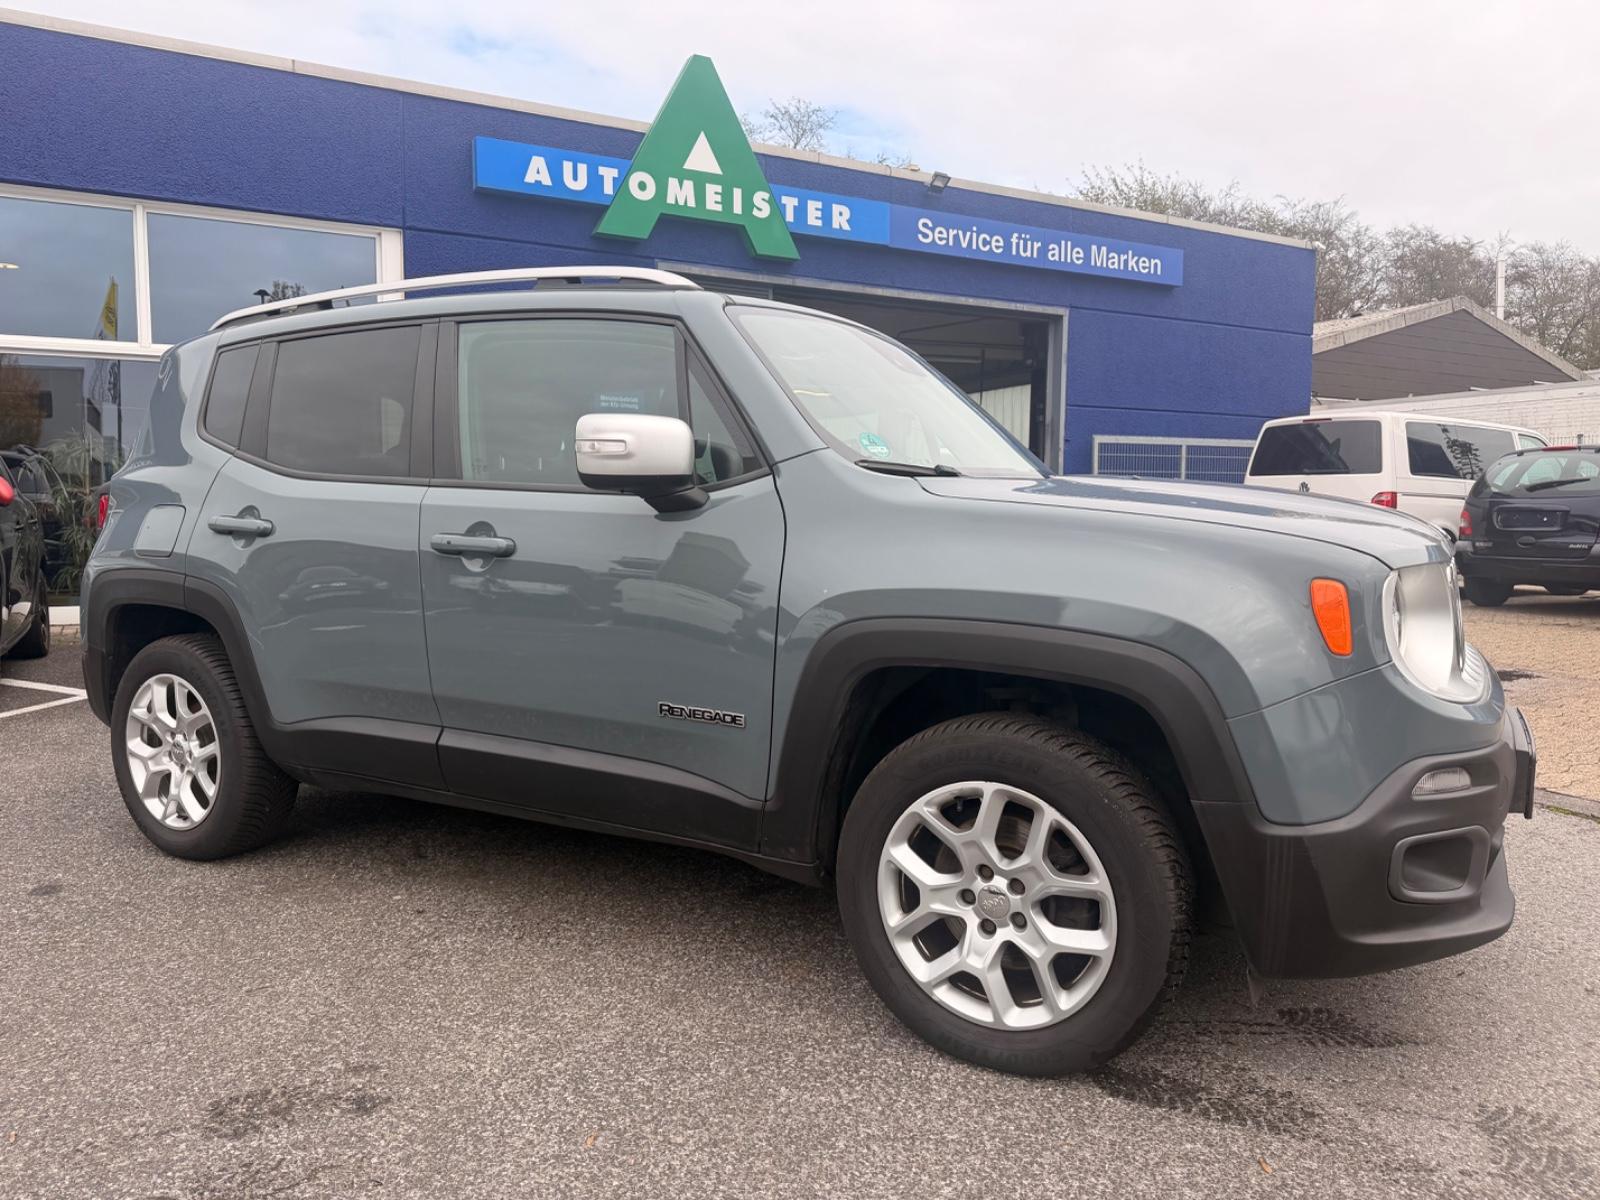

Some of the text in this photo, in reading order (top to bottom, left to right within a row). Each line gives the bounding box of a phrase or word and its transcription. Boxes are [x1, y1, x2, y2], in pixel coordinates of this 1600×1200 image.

[524, 156, 851, 231] AUTOMEISTER
[917, 217, 1163, 275] Service für alle Marken
[658, 701, 745, 728] RENEGADE
